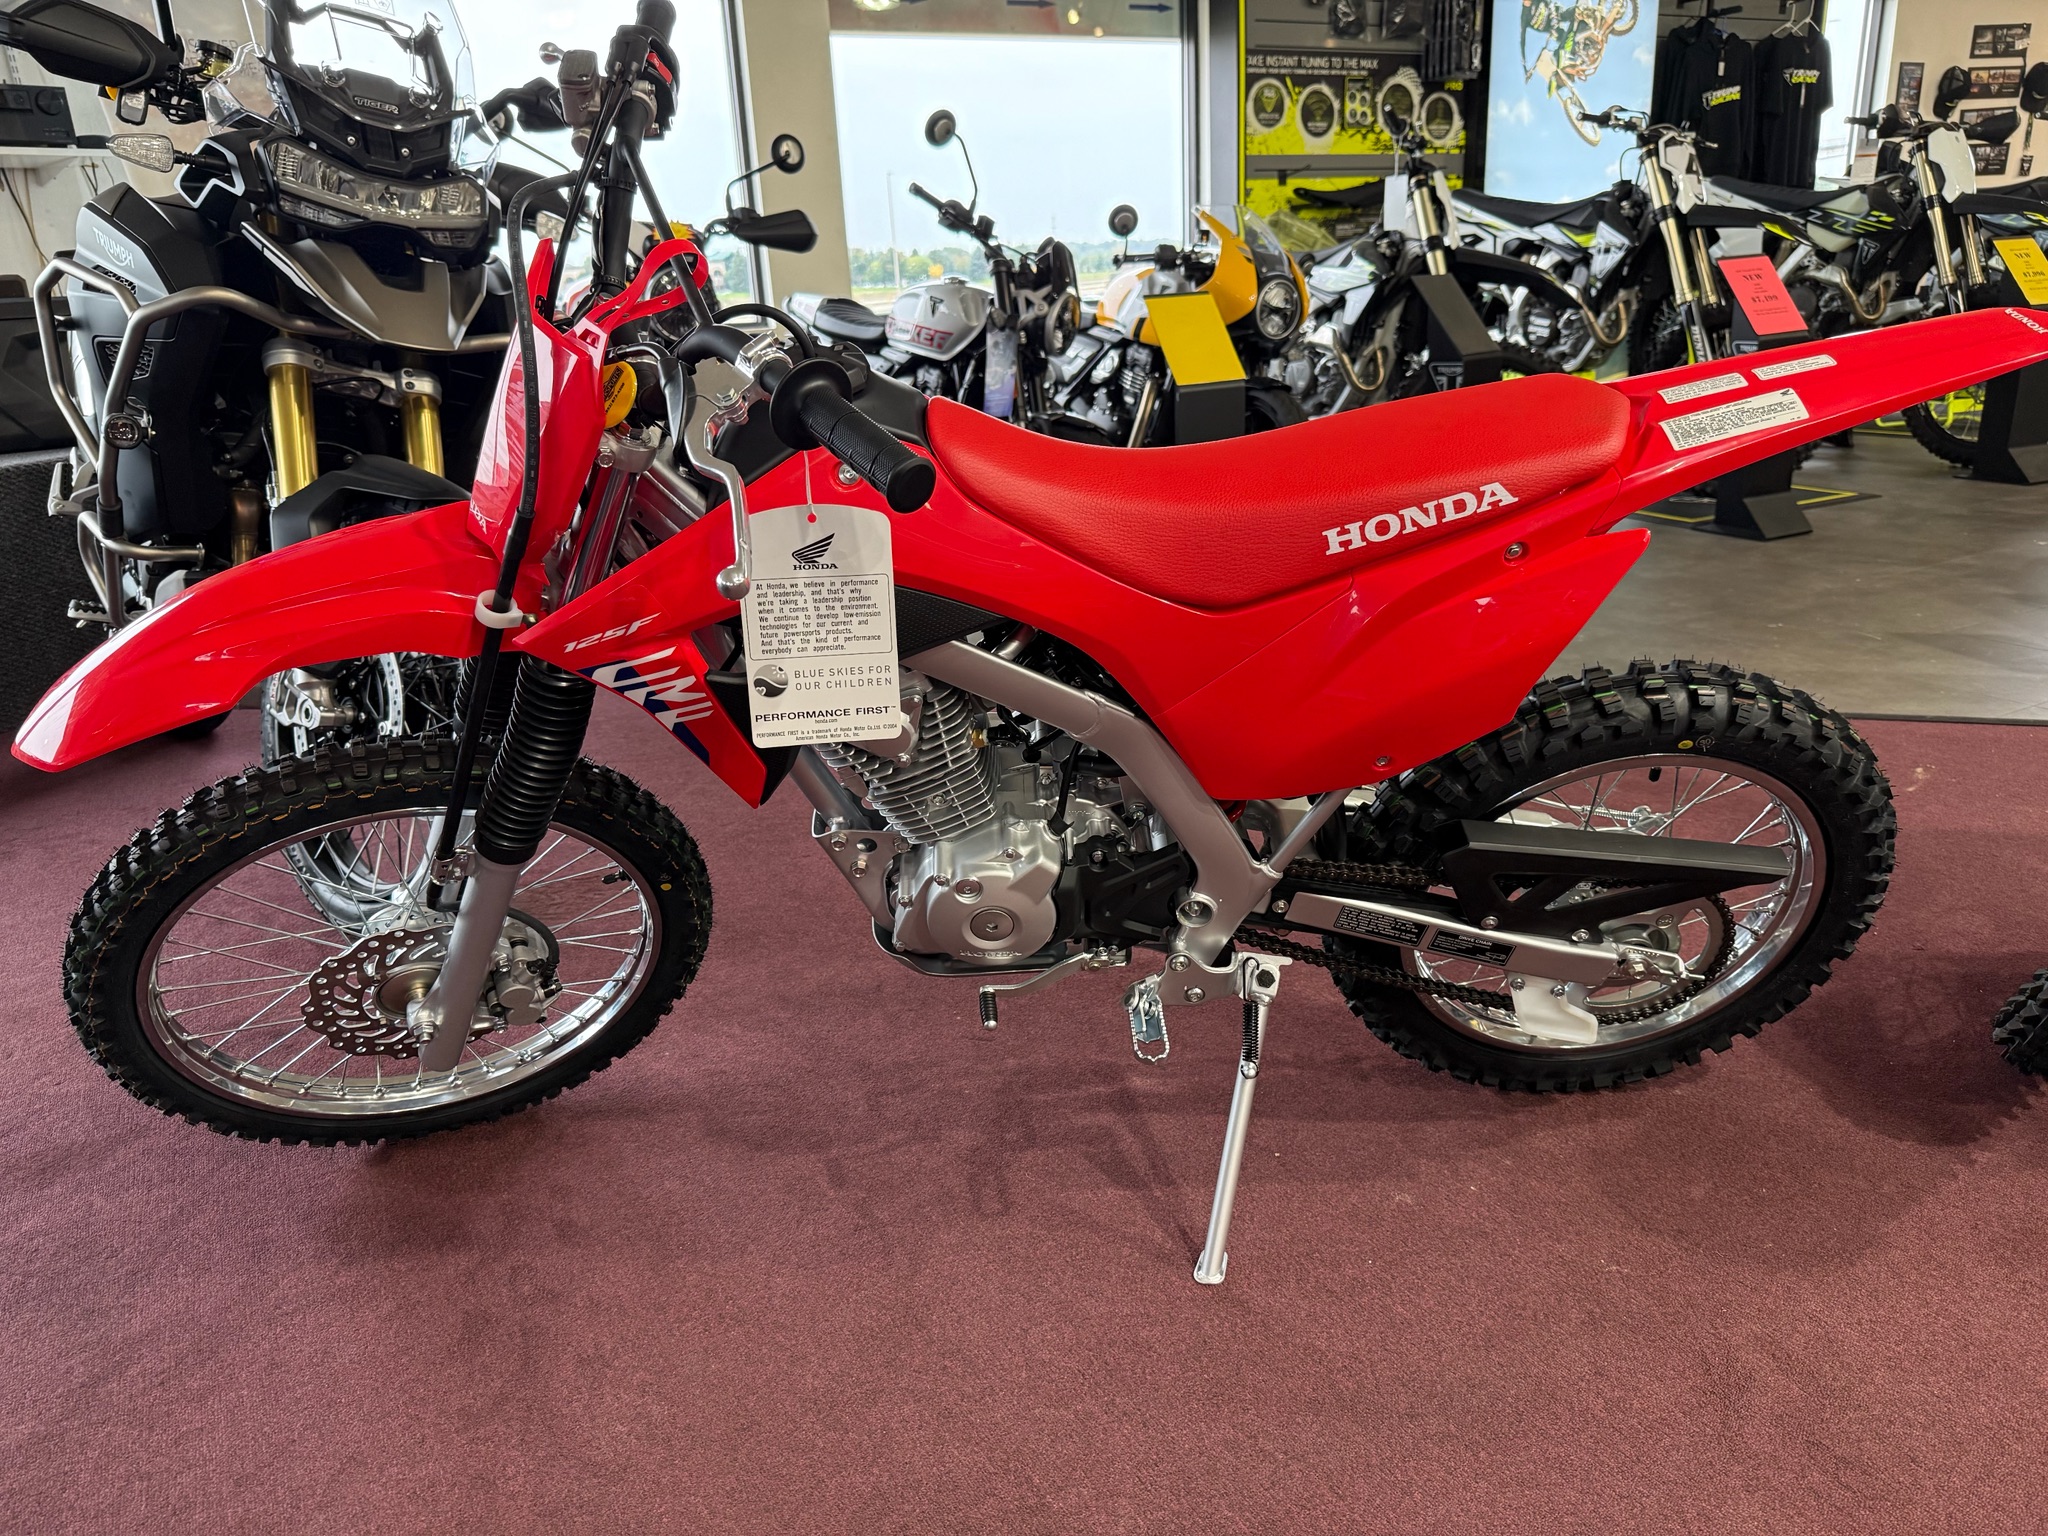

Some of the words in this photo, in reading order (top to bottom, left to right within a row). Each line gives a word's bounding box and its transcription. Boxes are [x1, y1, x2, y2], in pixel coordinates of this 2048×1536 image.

[1247, 55, 1264, 67] AKE
[1266, 56, 1299, 67] INSTANT
[1301, 57, 1329, 68] TUNING
[1331, 57, 1342, 69] TO
[1344, 58, 1359, 69] THE
[1360, 58, 1380, 70] MAX
[354, 96, 399, 115] TIGER
[92, 226, 135, 269] TRIUMPH
[2014, 252, 2031, 260] NEW
[1743, 273, 1763, 282] NEW
[1322, 481, 1519, 556] HONDA
[804, 580, 825, 588] believe
[841, 579, 878, 588] performance
[773, 590, 806, 599] leadership,
[850, 588, 861, 596] why
[757, 599, 774, 607] we're
[779, 598, 798, 606] taking
[779, 606, 784, 614] it
[816, 612, 839, 620] develop
[760, 623, 797, 631] technologies
[563, 612, 662, 654] 125F
[784, 630, 820, 638] powersports
[762, 647, 792, 655] everybody
[813, 644, 846, 652] appreciate.
[794, 669, 824, 679] BLUE
[829, 667, 864, 677] SKIES
[868, 665, 891, 674] FOR
[795, 682, 821, 691] OUR
[826, 678, 892, 689] CHILDREN
[755, 708, 851, 722] PERFORMANCE
[1458, 935, 1475, 943] DRIVE
[1475, 939, 1493, 947] CHAIN
